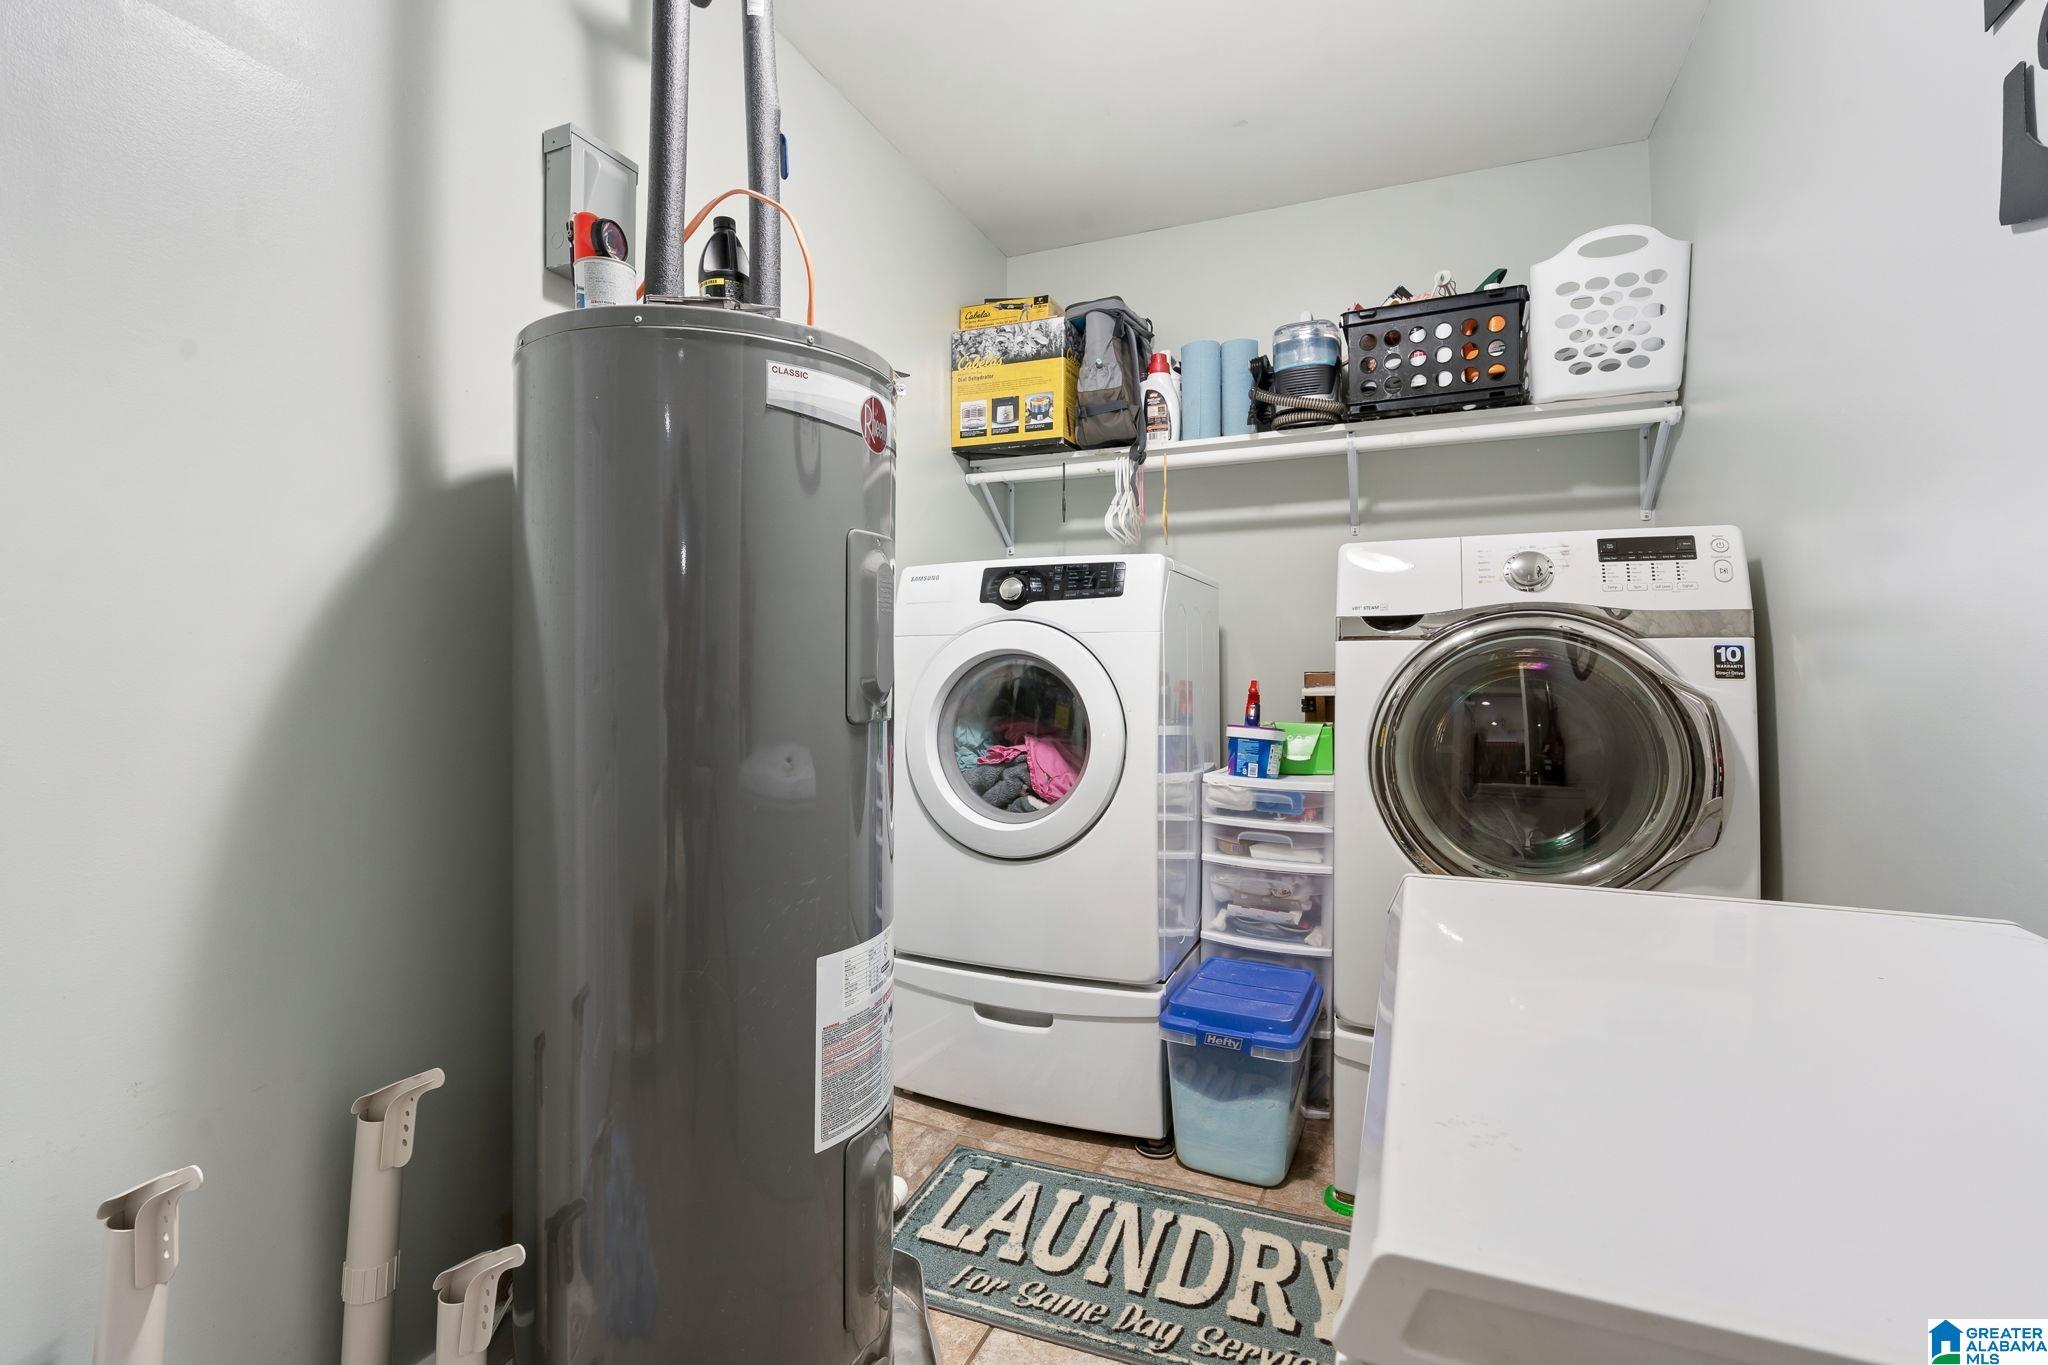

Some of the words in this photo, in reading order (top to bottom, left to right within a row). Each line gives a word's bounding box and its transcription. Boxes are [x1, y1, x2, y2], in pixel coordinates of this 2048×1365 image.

[771, 365, 809, 380] CLASSIC
[910, 574, 940, 582] SAMSUNG
[1716, 646, 1742, 662] 10
[1207, 1034, 1240, 1050] Hefty
[917, 1167, 1349, 1345] LAUNDRY
[949, 1264, 1010, 1297] For
[1011, 1280, 1110, 1324] Same
[1109, 1303, 1183, 1353] Day
